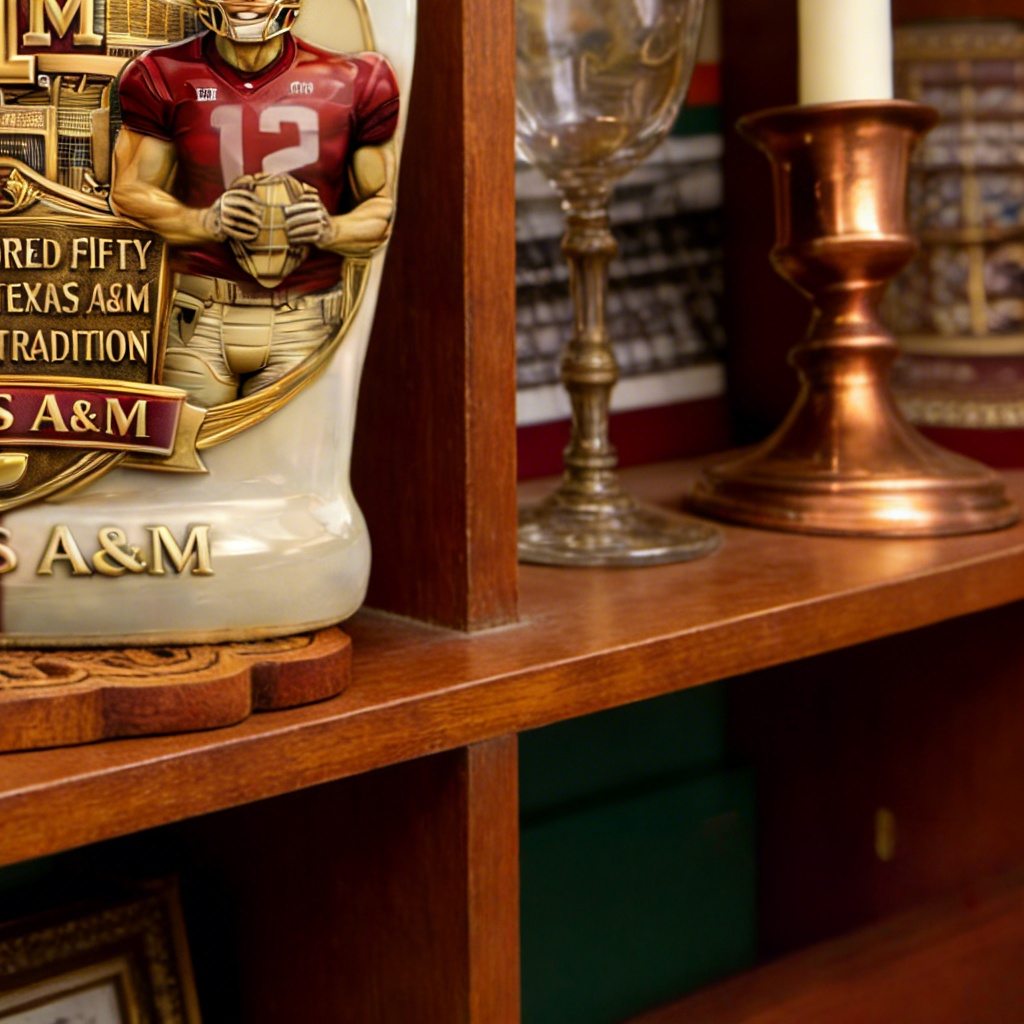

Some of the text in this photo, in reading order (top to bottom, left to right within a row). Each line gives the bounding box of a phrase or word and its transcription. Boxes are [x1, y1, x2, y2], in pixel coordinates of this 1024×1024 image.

[210, 104, 319, 190] 12
[70, 236, 153, 272] FIFTY
[85, 281, 151, 315] A&M
[30, 393, 151, 441] A&M
[36, 523, 215, 576] A&M
